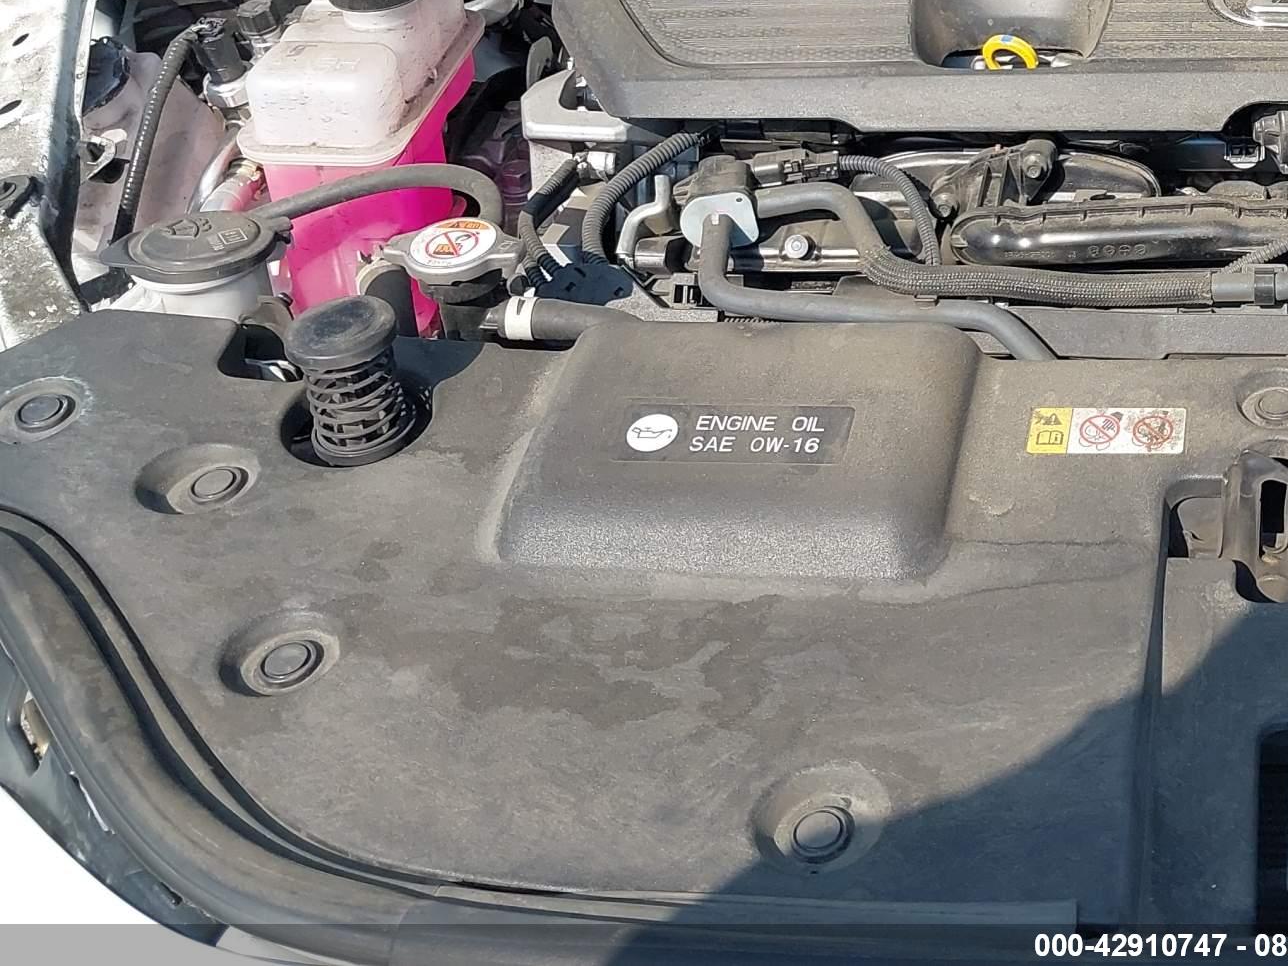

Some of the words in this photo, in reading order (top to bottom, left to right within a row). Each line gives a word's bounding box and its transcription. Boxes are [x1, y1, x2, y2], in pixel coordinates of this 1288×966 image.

[695, 415, 778, 432] ENGINE
[791, 416, 825, 432] OIL
[689, 436, 736, 453] SAE
[750, 437, 820, 454] 0W-16
